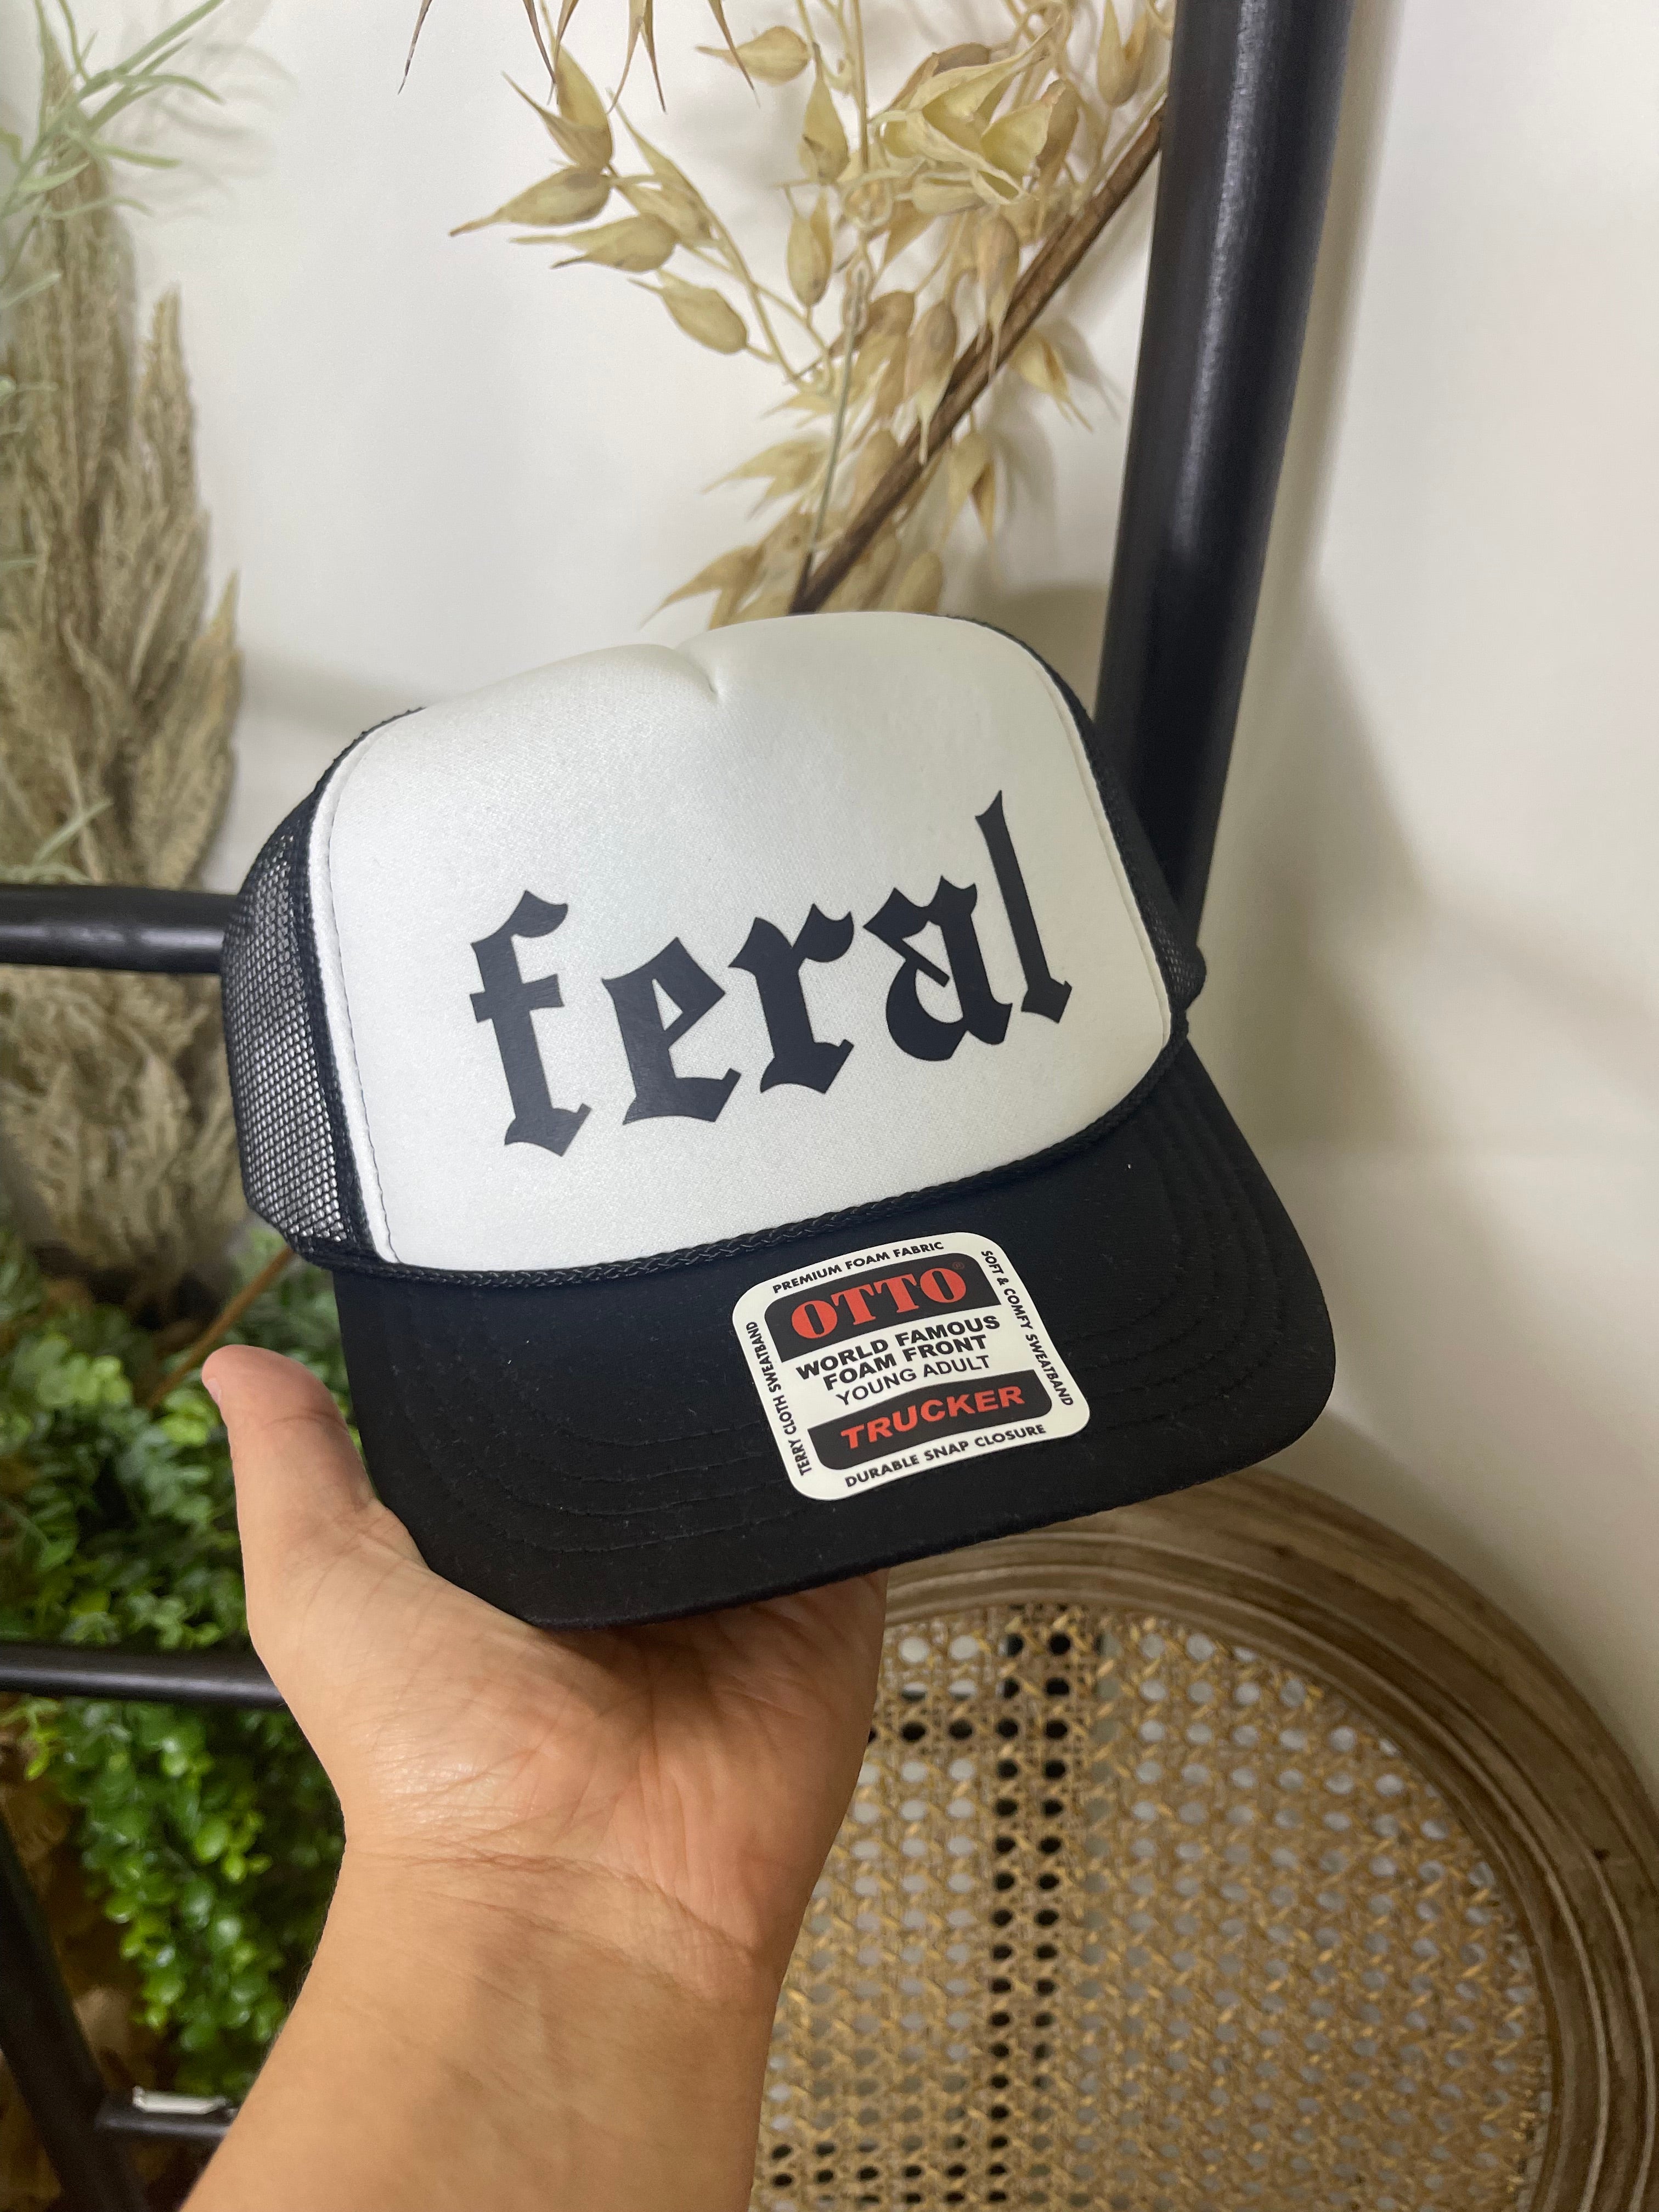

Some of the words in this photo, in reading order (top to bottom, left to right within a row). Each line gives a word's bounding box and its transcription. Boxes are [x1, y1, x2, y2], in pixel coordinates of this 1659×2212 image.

[470, 790, 1072, 1156] feral
[773, 1264, 842, 1294] PREMIUM
[845, 1250, 890, 1270] FOAM
[893, 1242, 944, 1259] FABRIC
[791, 1267, 967, 1339] OTTO
[981, 1250, 1003, 1276] SOFT
[997, 1278, 1008, 1286] &
[1003, 1288, 1032, 1330] COMFY
[1025, 1334, 1073, 1405] SWEATBAND
[747, 1322, 781, 1392] SWEATBAND
[796, 1339, 889, 1380] WORLD
[895, 1315, 1000, 1346] FAMOUS
[823, 1357, 897, 1391] FOAM
[902, 1335, 987, 1362] FRONT
[836, 1369, 916, 1406] YOUNG
[923, 1355, 990, 1378] ADULT
[774, 1395, 797, 1436] CLOTH
[841, 1386, 1025, 1449] TRUCKER
[789, 1439, 811, 1475] TERRY
[845, 1455, 919, 1487] DURABLE
[923, 1440, 969, 1461] SNAP
[974, 1425, 1046, 1448] CLOSURE
